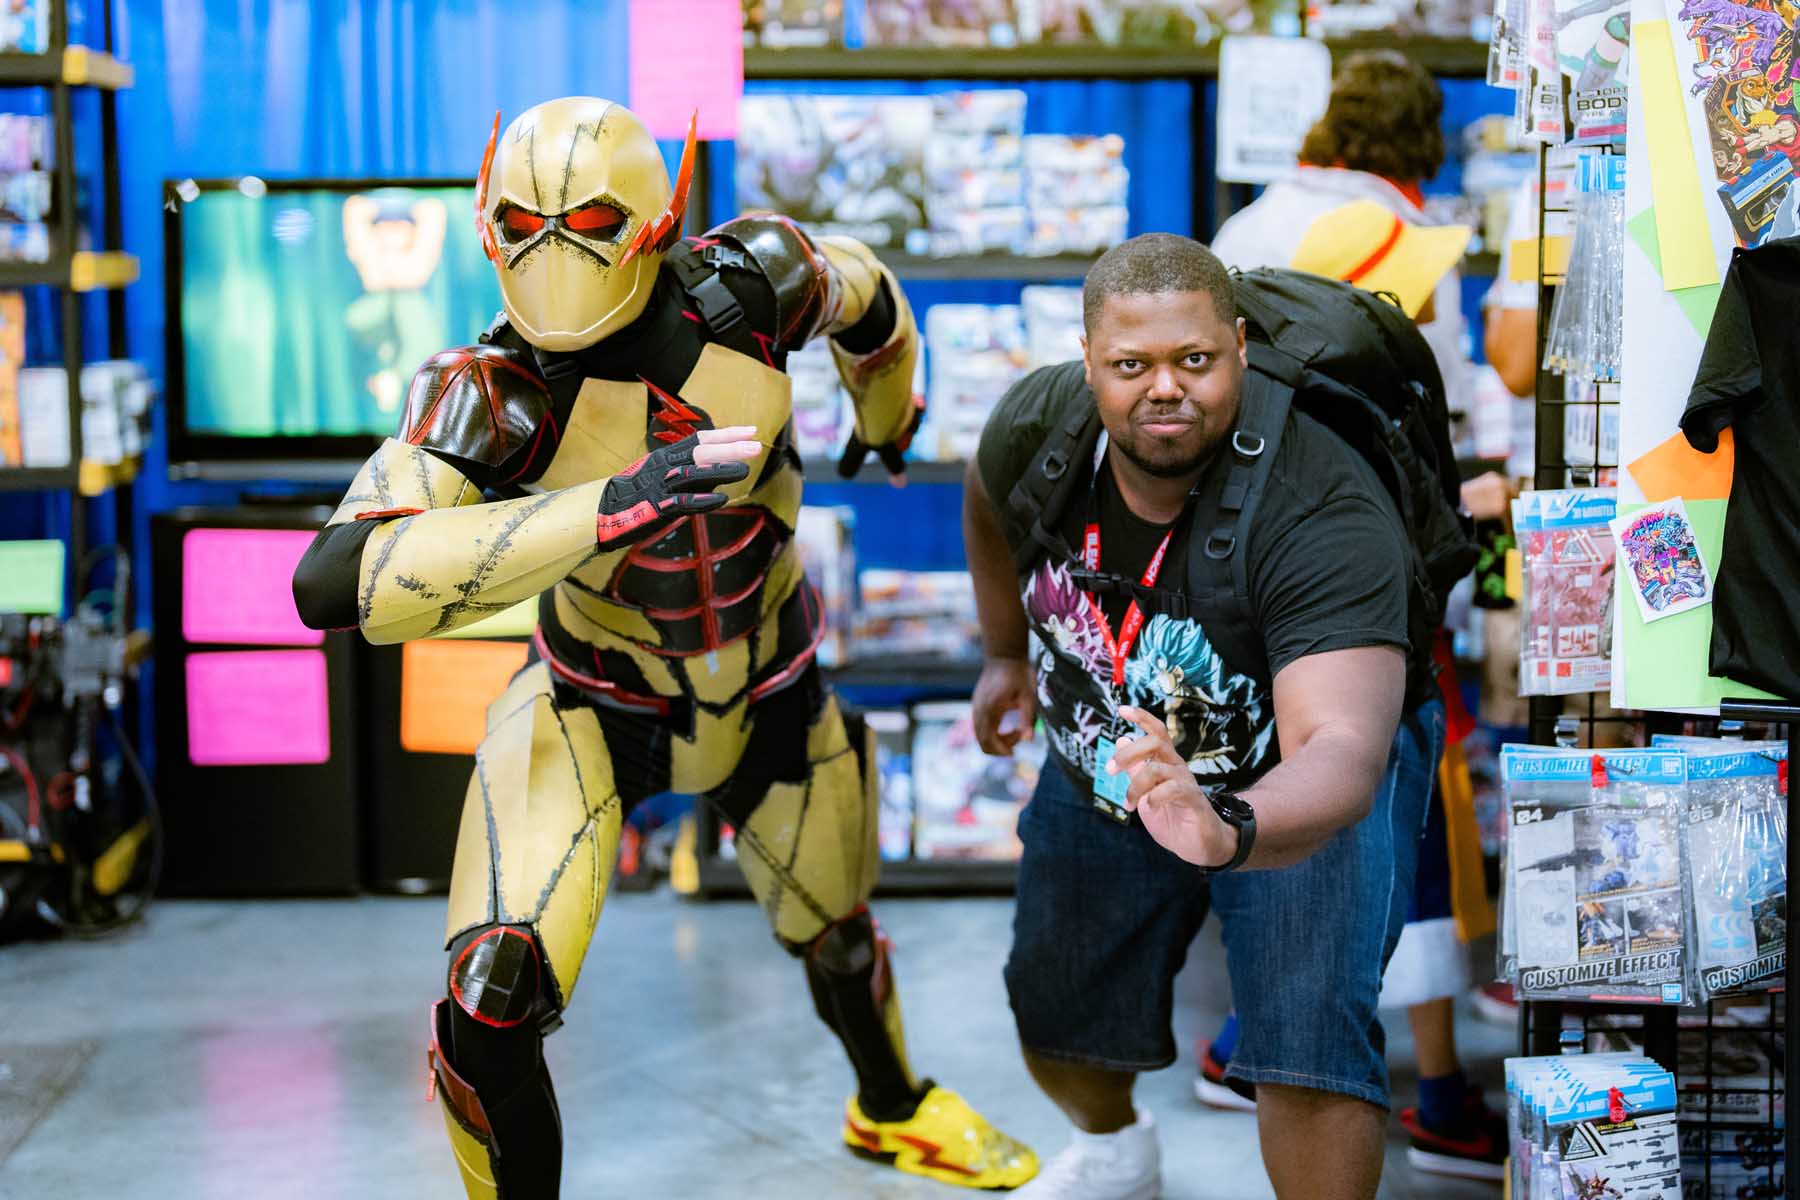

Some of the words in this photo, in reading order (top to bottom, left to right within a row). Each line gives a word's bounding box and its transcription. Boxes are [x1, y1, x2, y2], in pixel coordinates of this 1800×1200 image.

[599, 508, 646, 530] HYPER-FIT
[1085, 532, 1098, 571] BLEAC
[1512, 758, 1588, 774] CUSTOMIZE
[1516, 807, 1544, 825] 04
[1523, 960, 1616, 990] CUSTOMIZE
[1622, 950, 1681, 974] EFFECT
